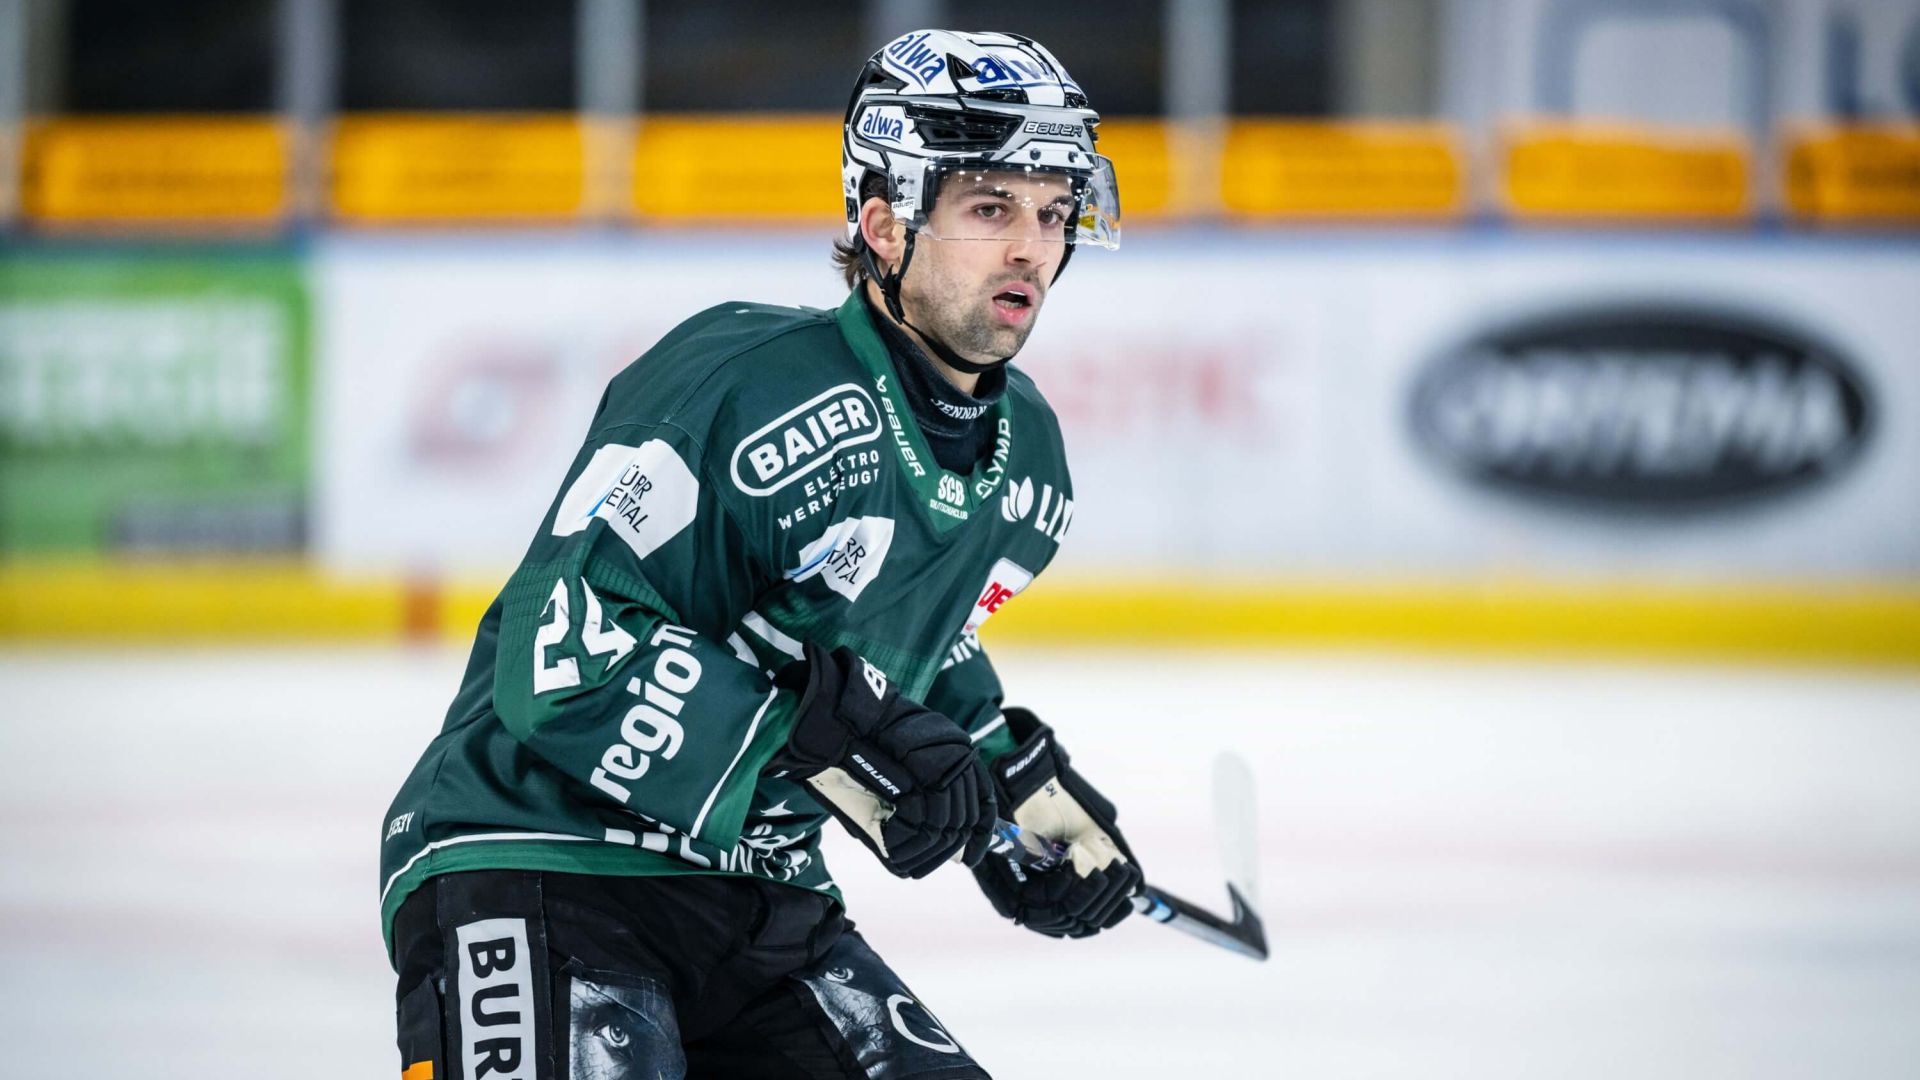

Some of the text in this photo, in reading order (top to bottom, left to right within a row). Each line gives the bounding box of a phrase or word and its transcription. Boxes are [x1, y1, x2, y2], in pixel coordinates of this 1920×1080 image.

[888, 33, 945, 85] alwa
[864, 108, 903, 138] alwa
[748, 396, 872, 482] BAIER
[804, 450, 879, 497] ELEKTRO
[938, 474, 965, 507] SCB
[534, 576, 638, 695] 24
[852, 754, 900, 795] BAUER
[1006, 738, 1047, 778] BAUER
